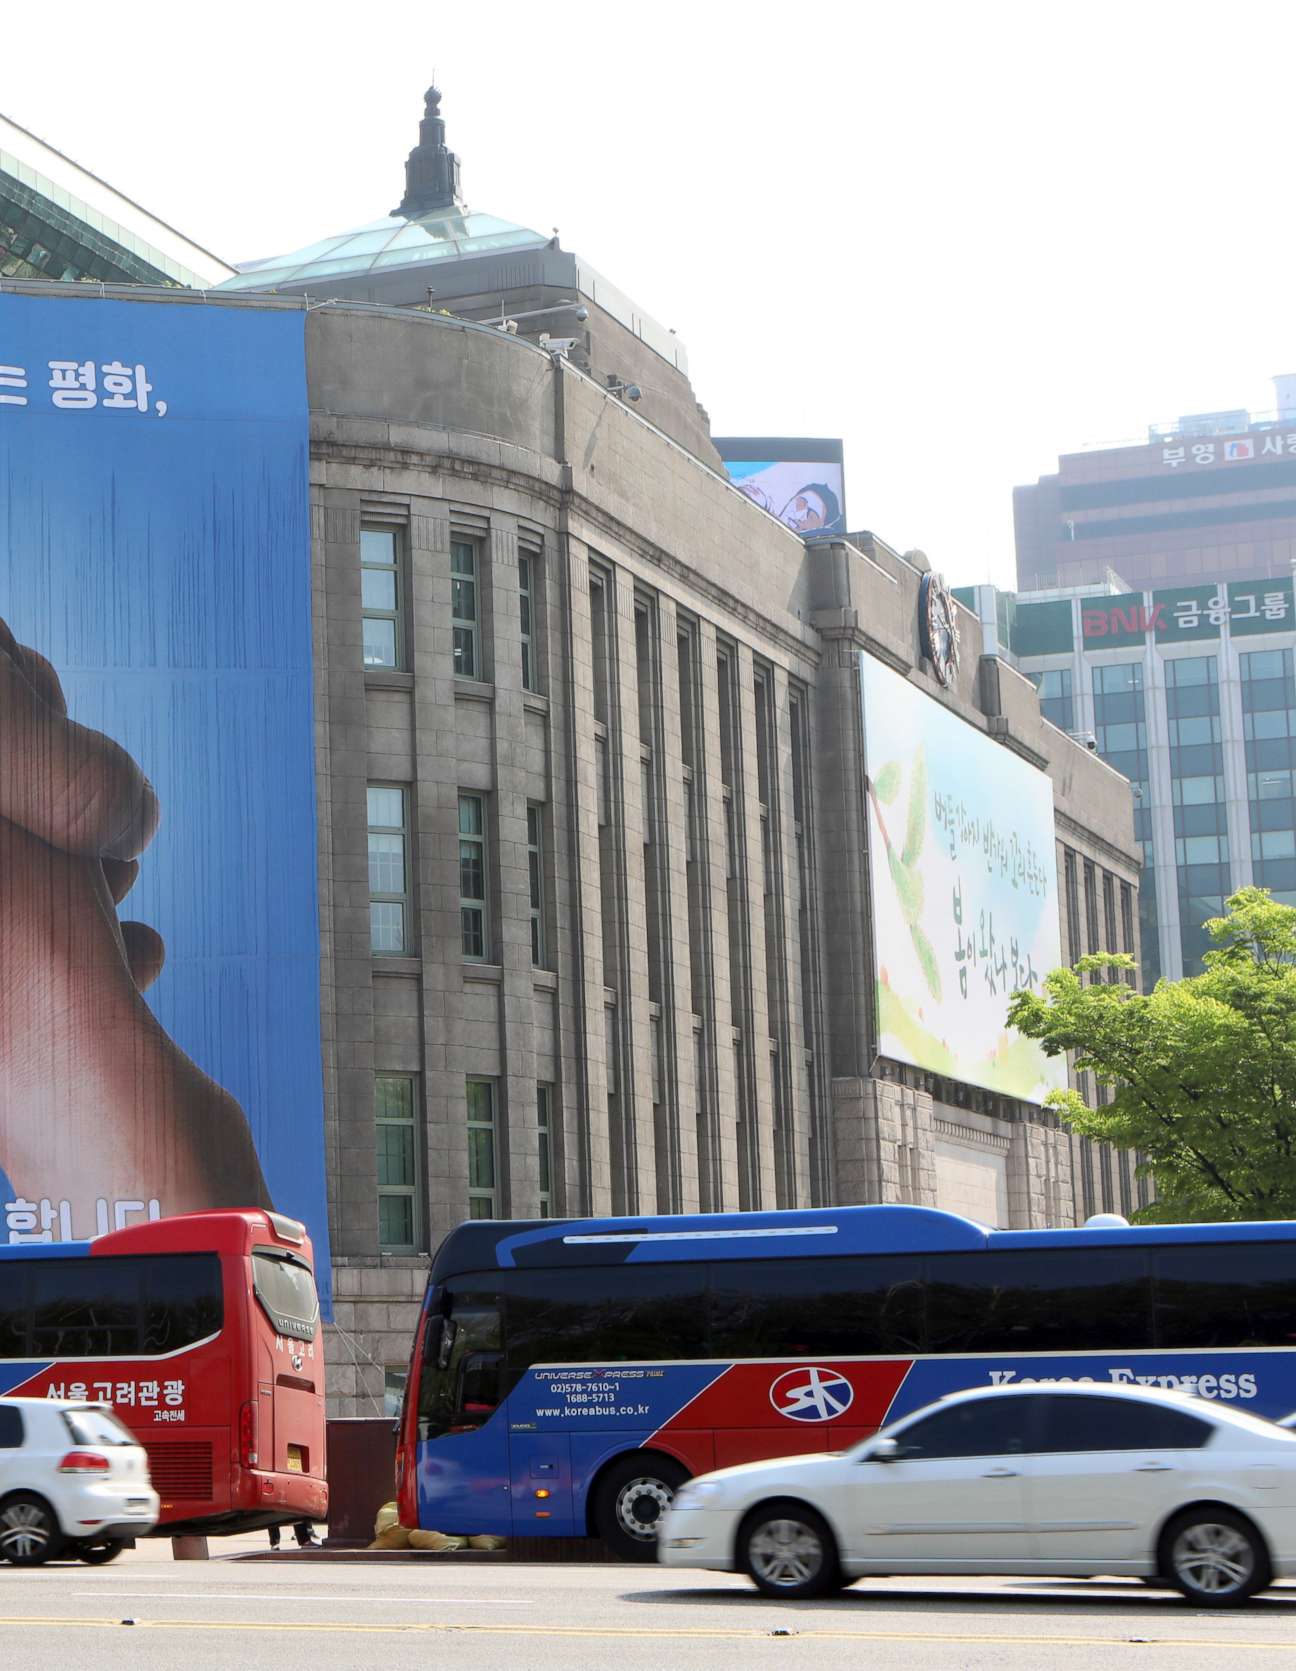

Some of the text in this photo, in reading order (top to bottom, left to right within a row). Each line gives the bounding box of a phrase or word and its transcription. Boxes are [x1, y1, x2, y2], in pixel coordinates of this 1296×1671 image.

[47, 360, 167, 417] 평화,
[1162, 443, 1217, 468] 부영
[1081, 591, 1290, 637] BNK 금융그룹
[952, 874, 977, 1000] 봄이
[45, 1380, 185, 1407] 서울고려관광
[550, 1382, 620, 1393] 02)578-7610~1
[565, 1392, 616, 1403] 1688-5713
[536, 1403, 650, 1418] www.koreabus.co.kr
